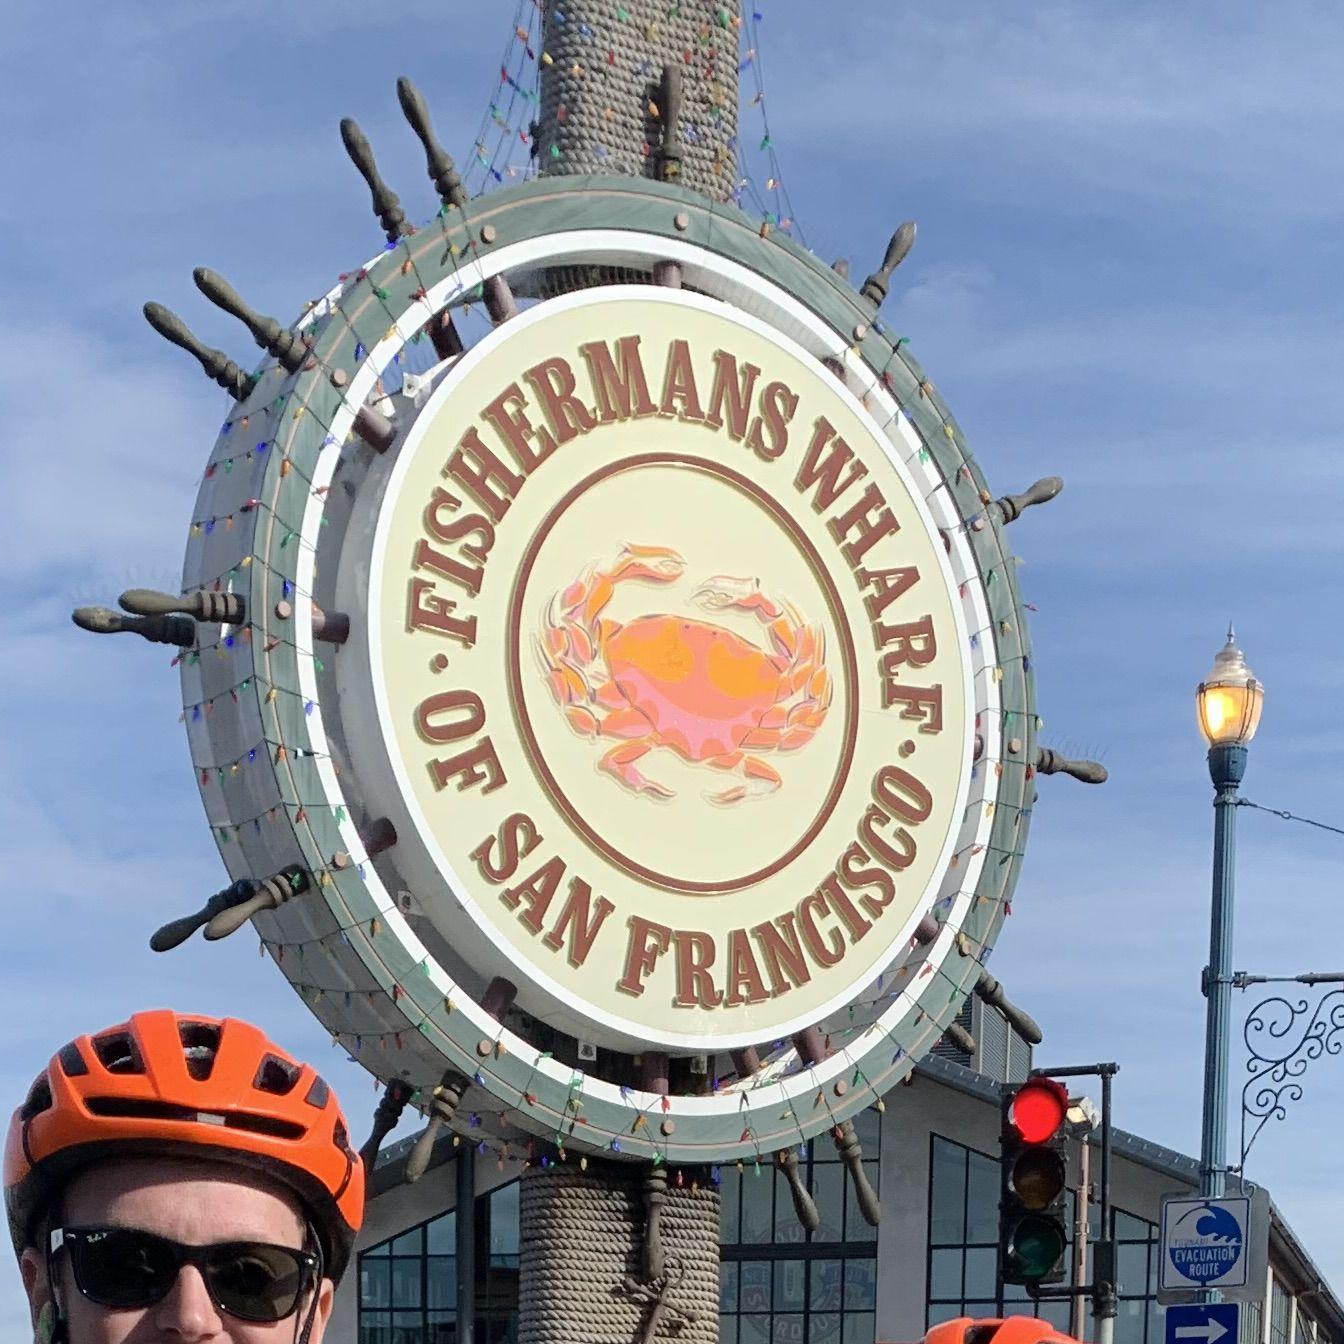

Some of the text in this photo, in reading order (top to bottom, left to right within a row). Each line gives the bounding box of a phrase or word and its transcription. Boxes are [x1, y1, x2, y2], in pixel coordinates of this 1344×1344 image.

[406, 334, 944, 736] FISHERMANS WHARF
[417, 688, 934, 1010] OF SAN FRANCISCO
[1176, 1247, 1235, 1263] EVACUATION
[1189, 1263, 1220, 1276] ROUTE
